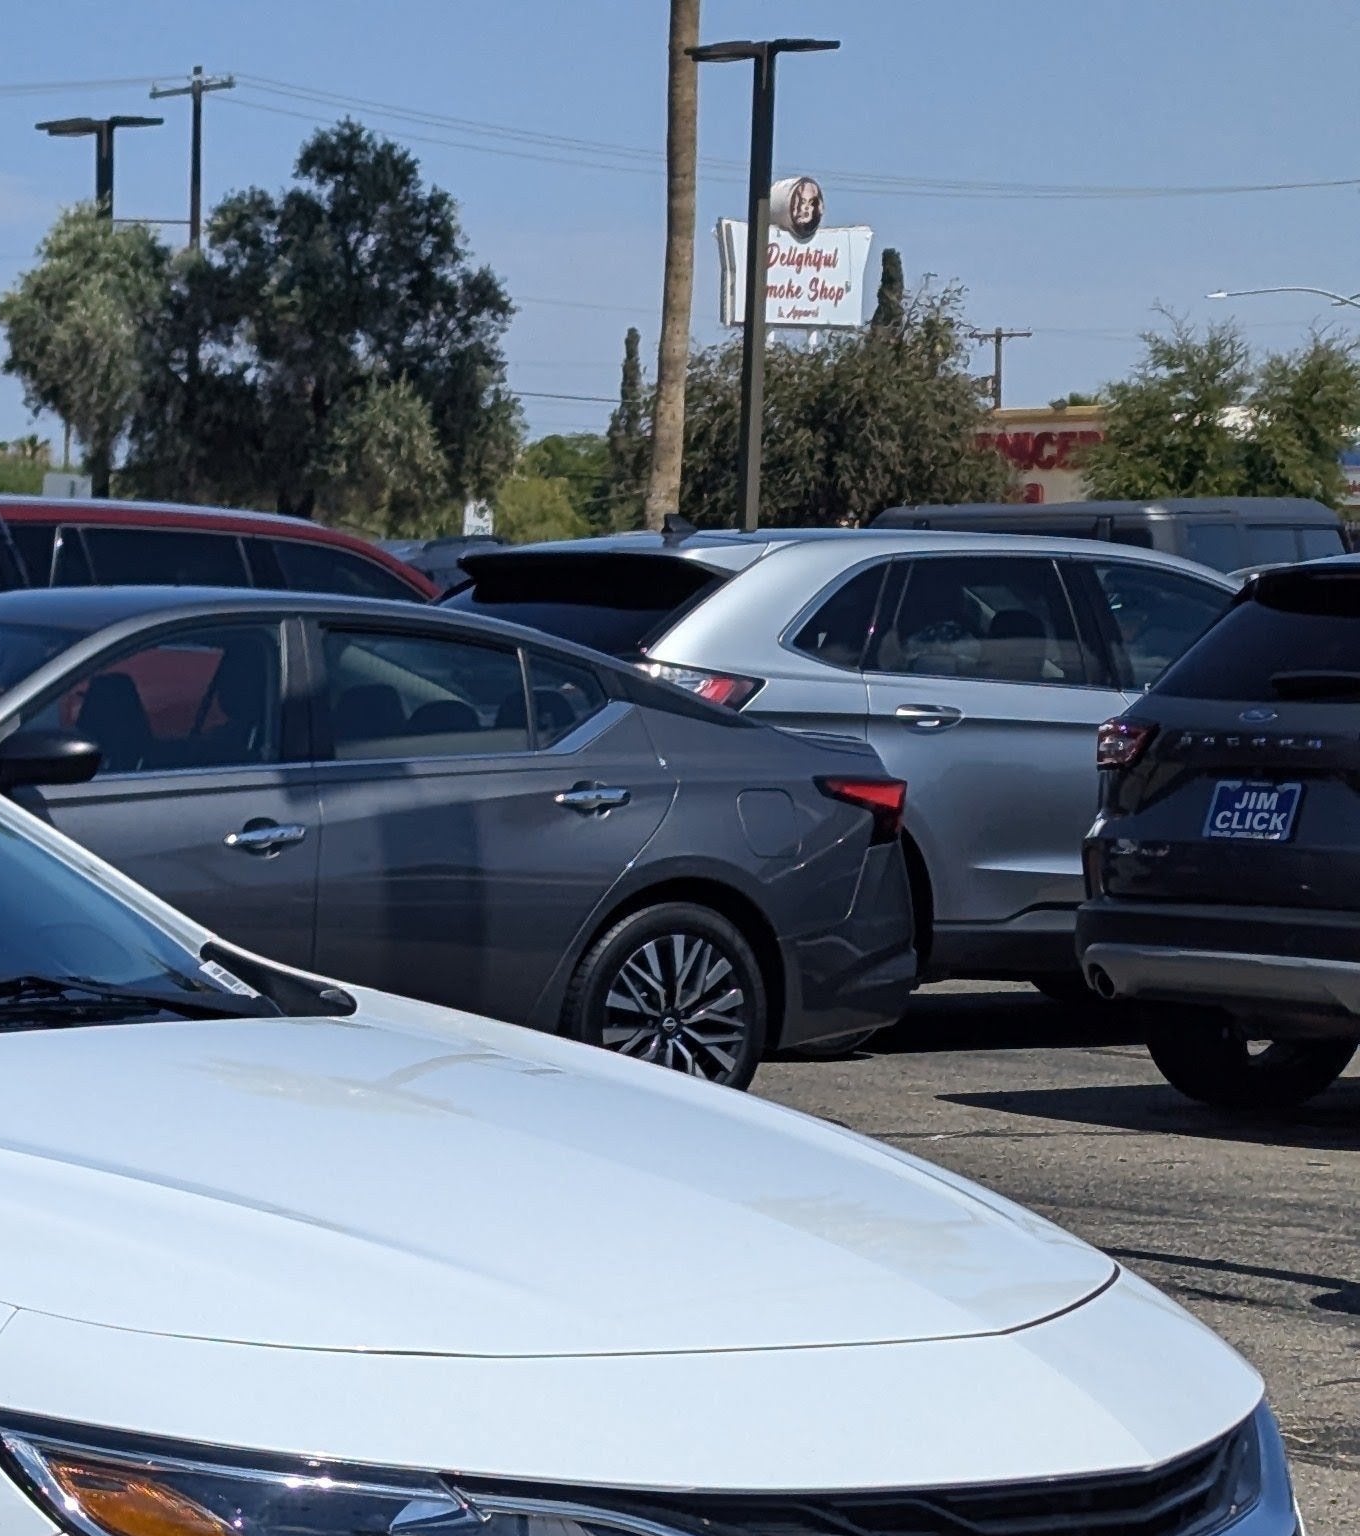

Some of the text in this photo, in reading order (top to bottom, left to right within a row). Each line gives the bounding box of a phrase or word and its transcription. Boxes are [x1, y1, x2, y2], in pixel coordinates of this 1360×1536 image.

[766, 276, 845, 308] moke Shop
[1234, 791, 1279, 810] JIM
[1215, 811, 1288, 831] CLICK
